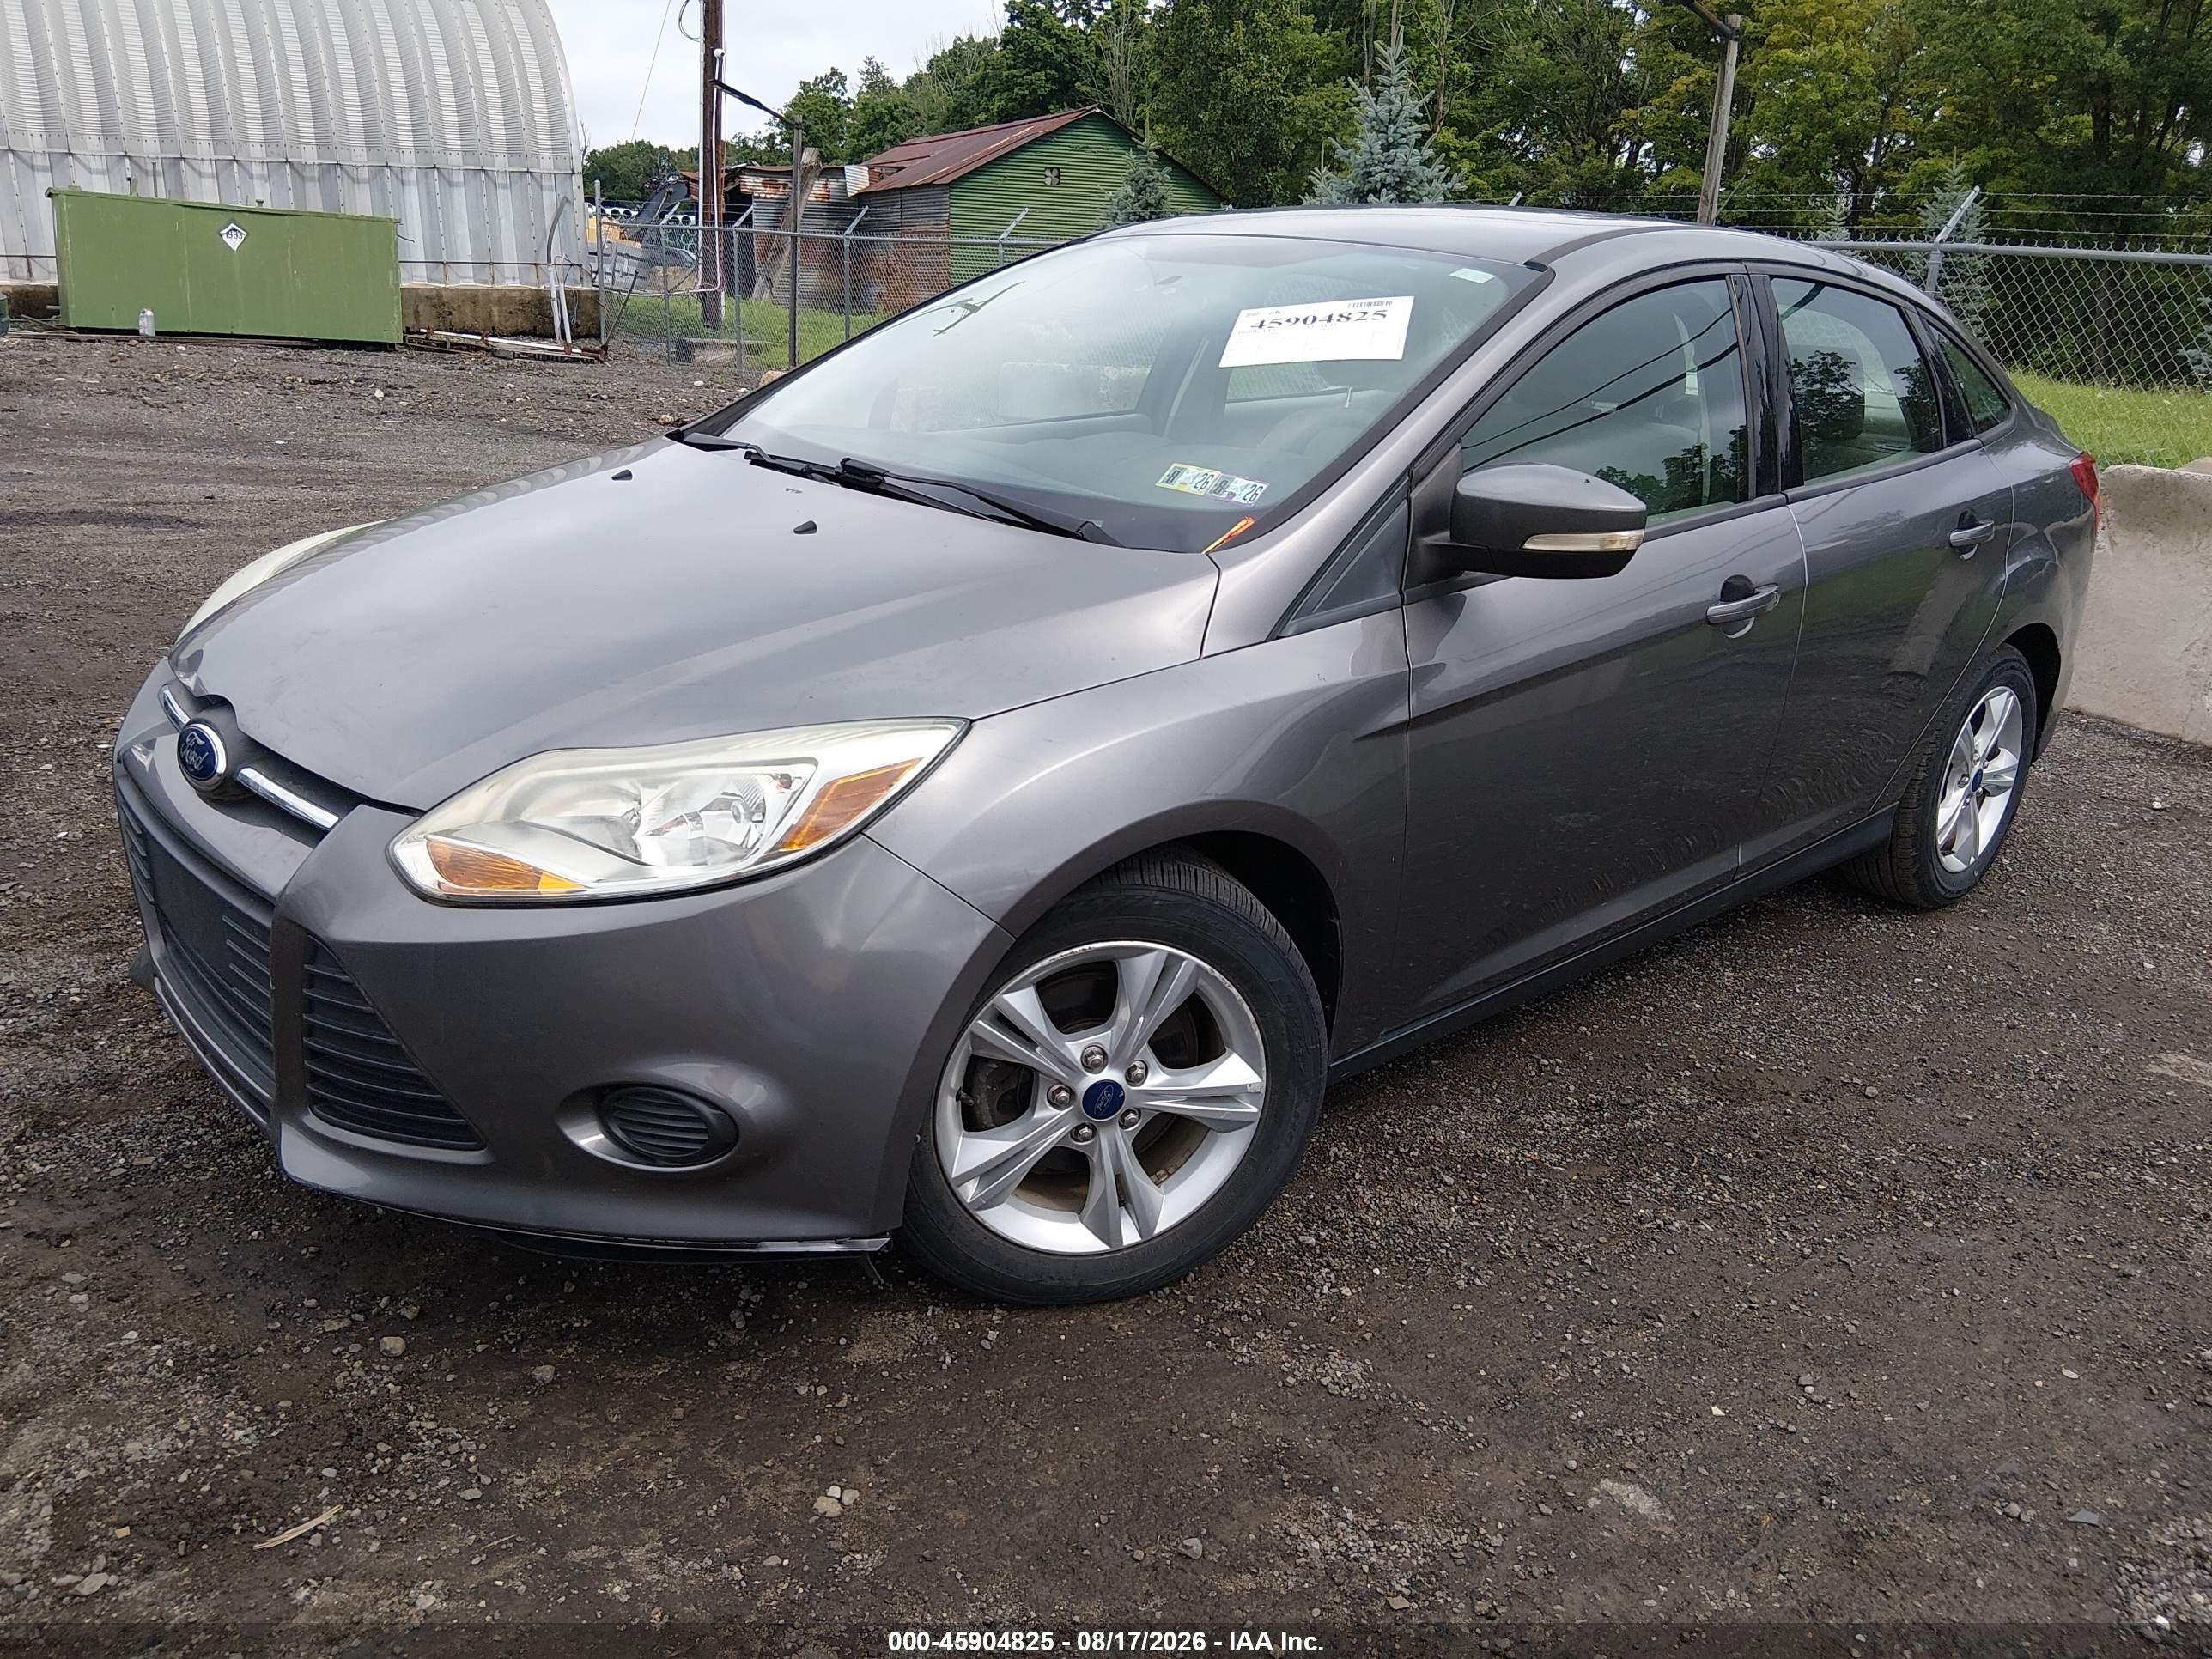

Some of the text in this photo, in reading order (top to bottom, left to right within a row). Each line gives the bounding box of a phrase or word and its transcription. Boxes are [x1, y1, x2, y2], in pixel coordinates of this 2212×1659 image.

[225, 229, 243, 240] 1993
[1250, 309, 1389, 330] 45904825
[1194, 472, 1214, 489] 26
[1242, 484, 1263, 502] 26
[180, 732, 210, 772] Ford
